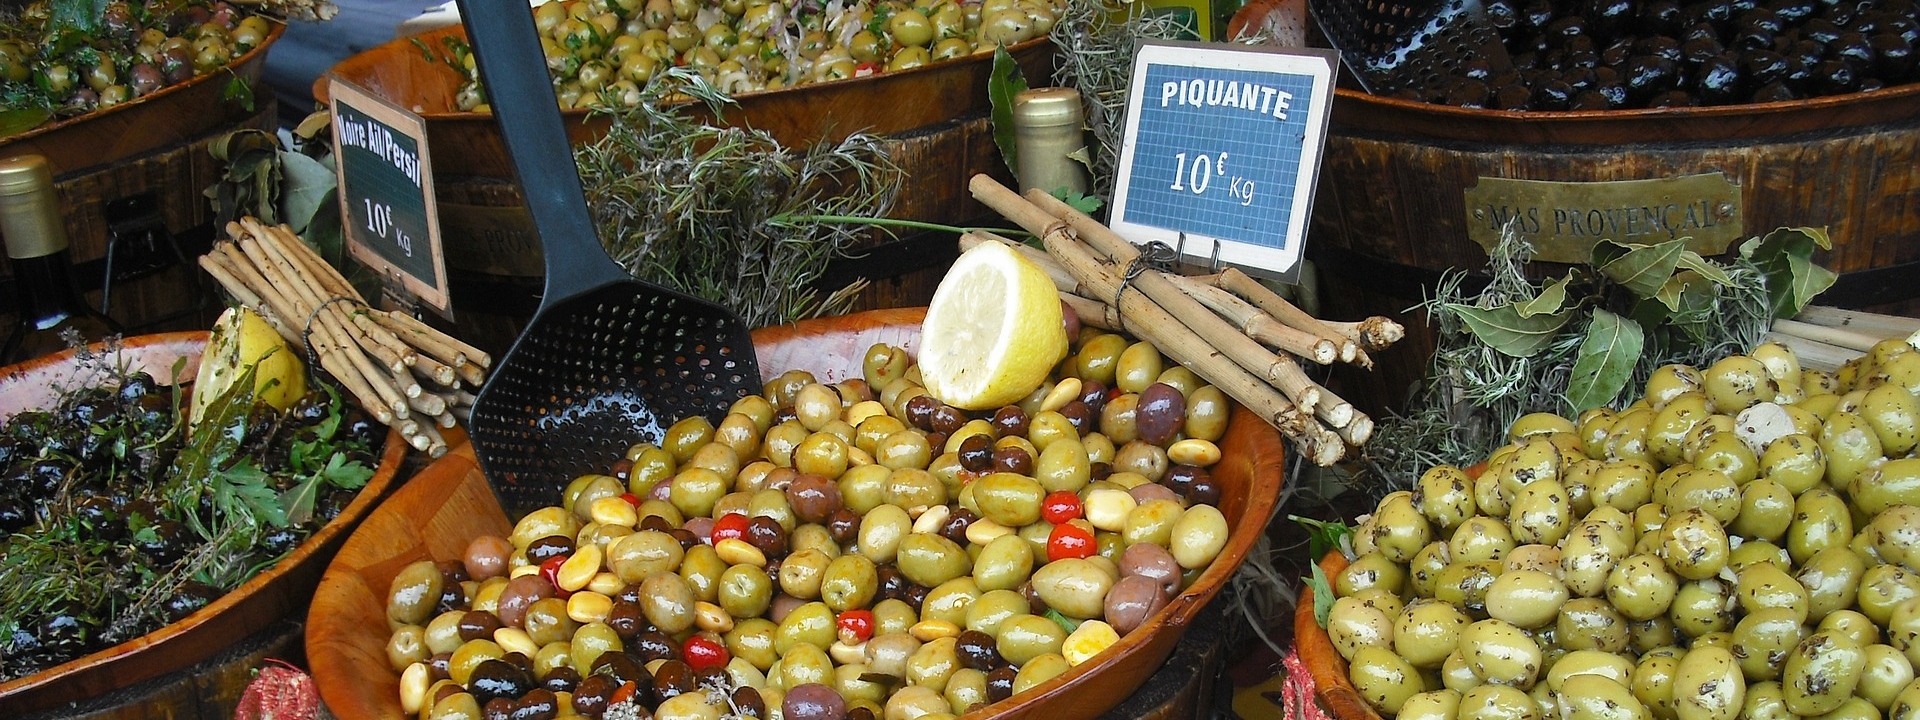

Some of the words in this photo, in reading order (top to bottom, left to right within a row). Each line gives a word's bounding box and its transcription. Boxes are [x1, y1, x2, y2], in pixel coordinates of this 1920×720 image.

[1161, 79, 1293, 120] PIQUANTE
[337, 114, 366, 149] Noire
[367, 120, 421, 189] Ail/Persil
[1228, 175, 1255, 206] Kg
[1487, 203, 1541, 235] MAS
[1553, 200, 1718, 239] PROVENÇAL
[396, 228, 412, 258] Kg
